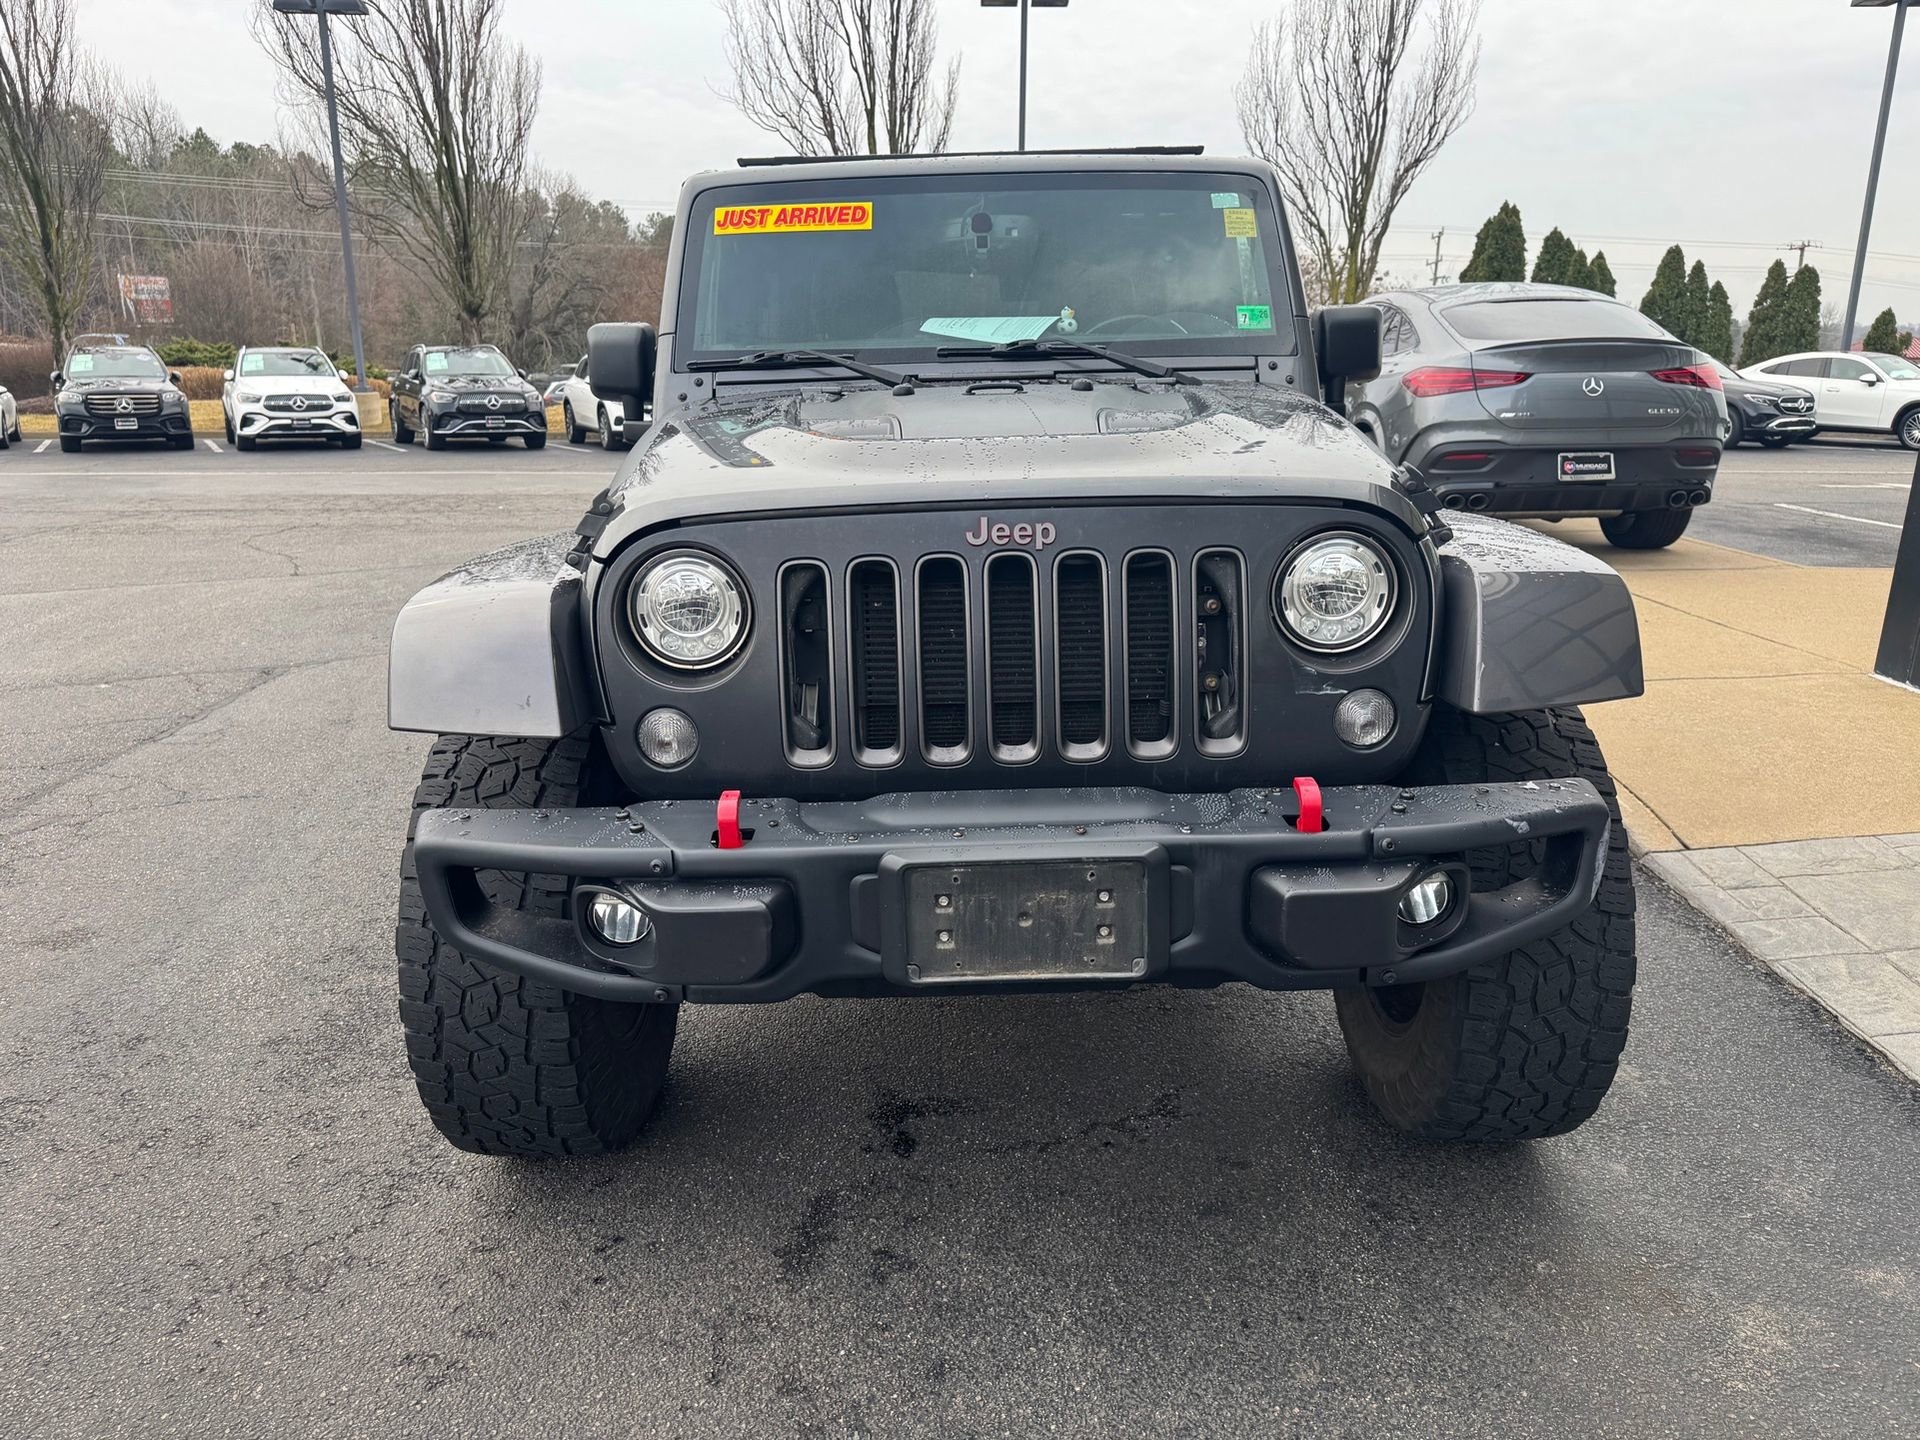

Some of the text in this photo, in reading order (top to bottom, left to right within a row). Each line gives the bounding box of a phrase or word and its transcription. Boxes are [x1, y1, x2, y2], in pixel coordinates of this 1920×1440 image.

[717, 205, 868, 229] JUST ARRIVED
[1241, 313, 1247, 324] 7
[965, 516, 1056, 550] Jeep
